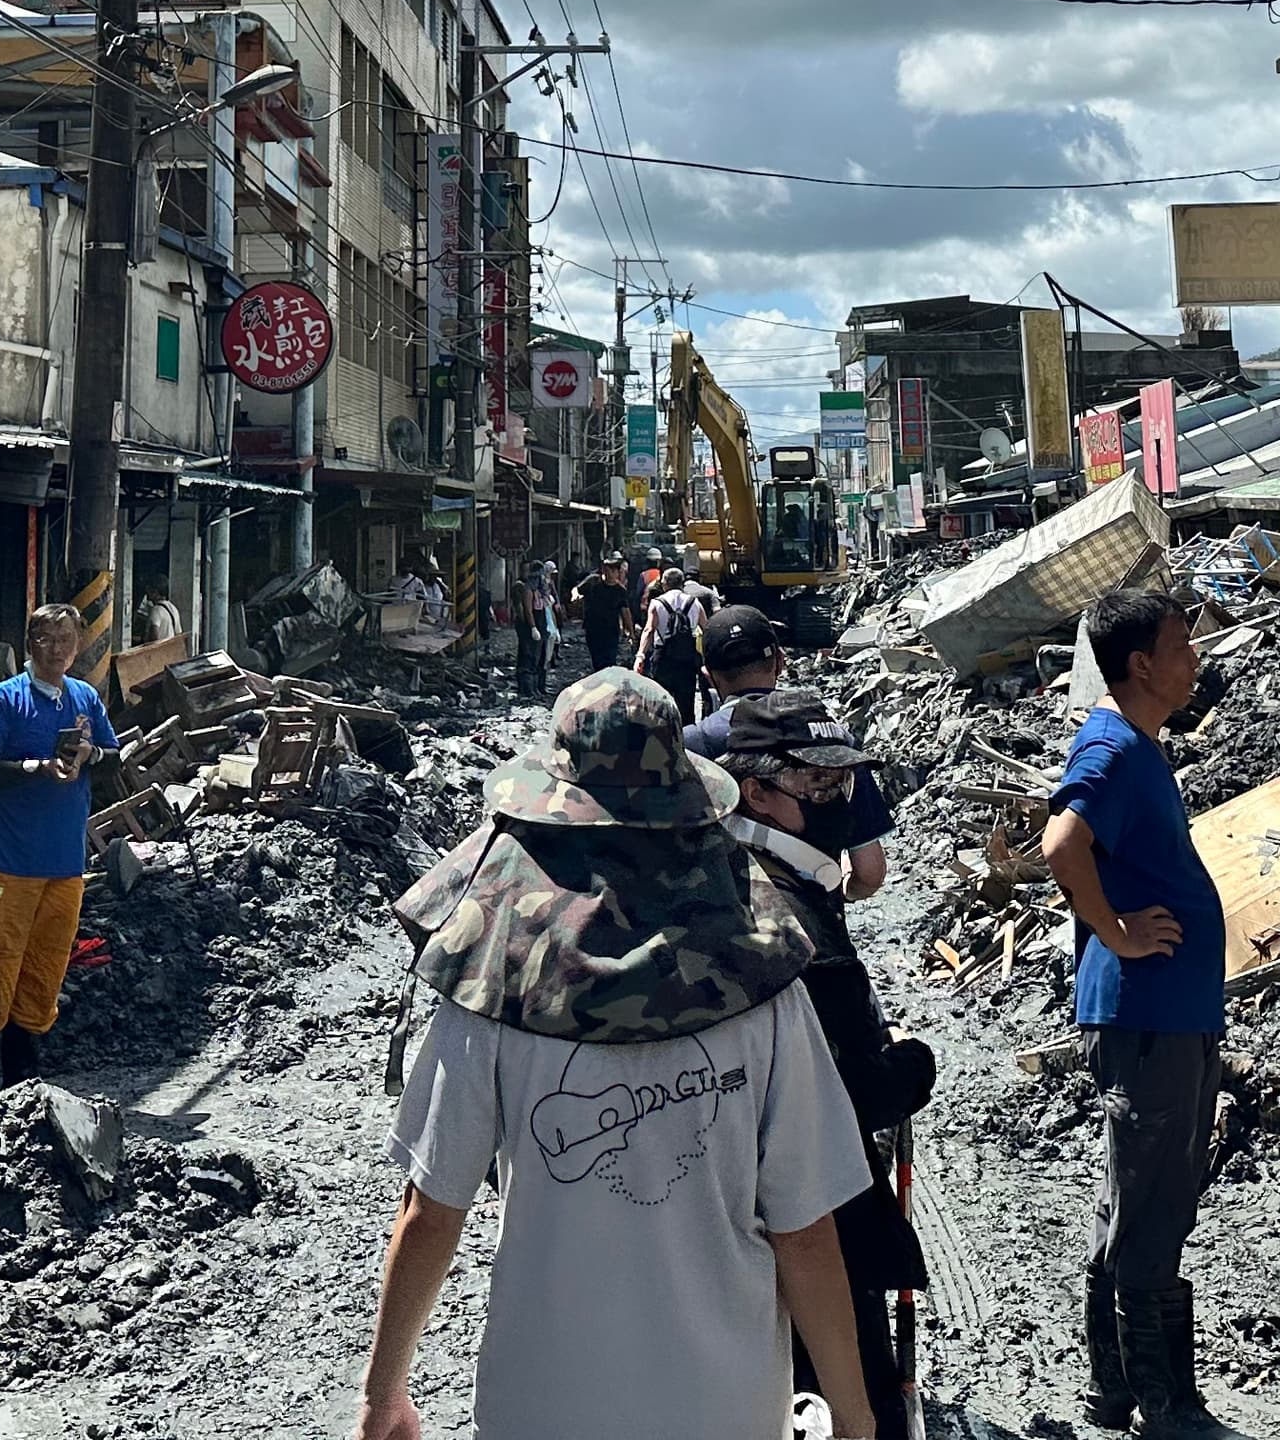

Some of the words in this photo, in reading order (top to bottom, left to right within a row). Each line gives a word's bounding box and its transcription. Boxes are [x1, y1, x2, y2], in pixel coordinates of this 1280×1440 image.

[273, 296, 310, 321] 手工
[233, 316, 326, 372] 水煎包
[542, 372, 578, 391] SYM
